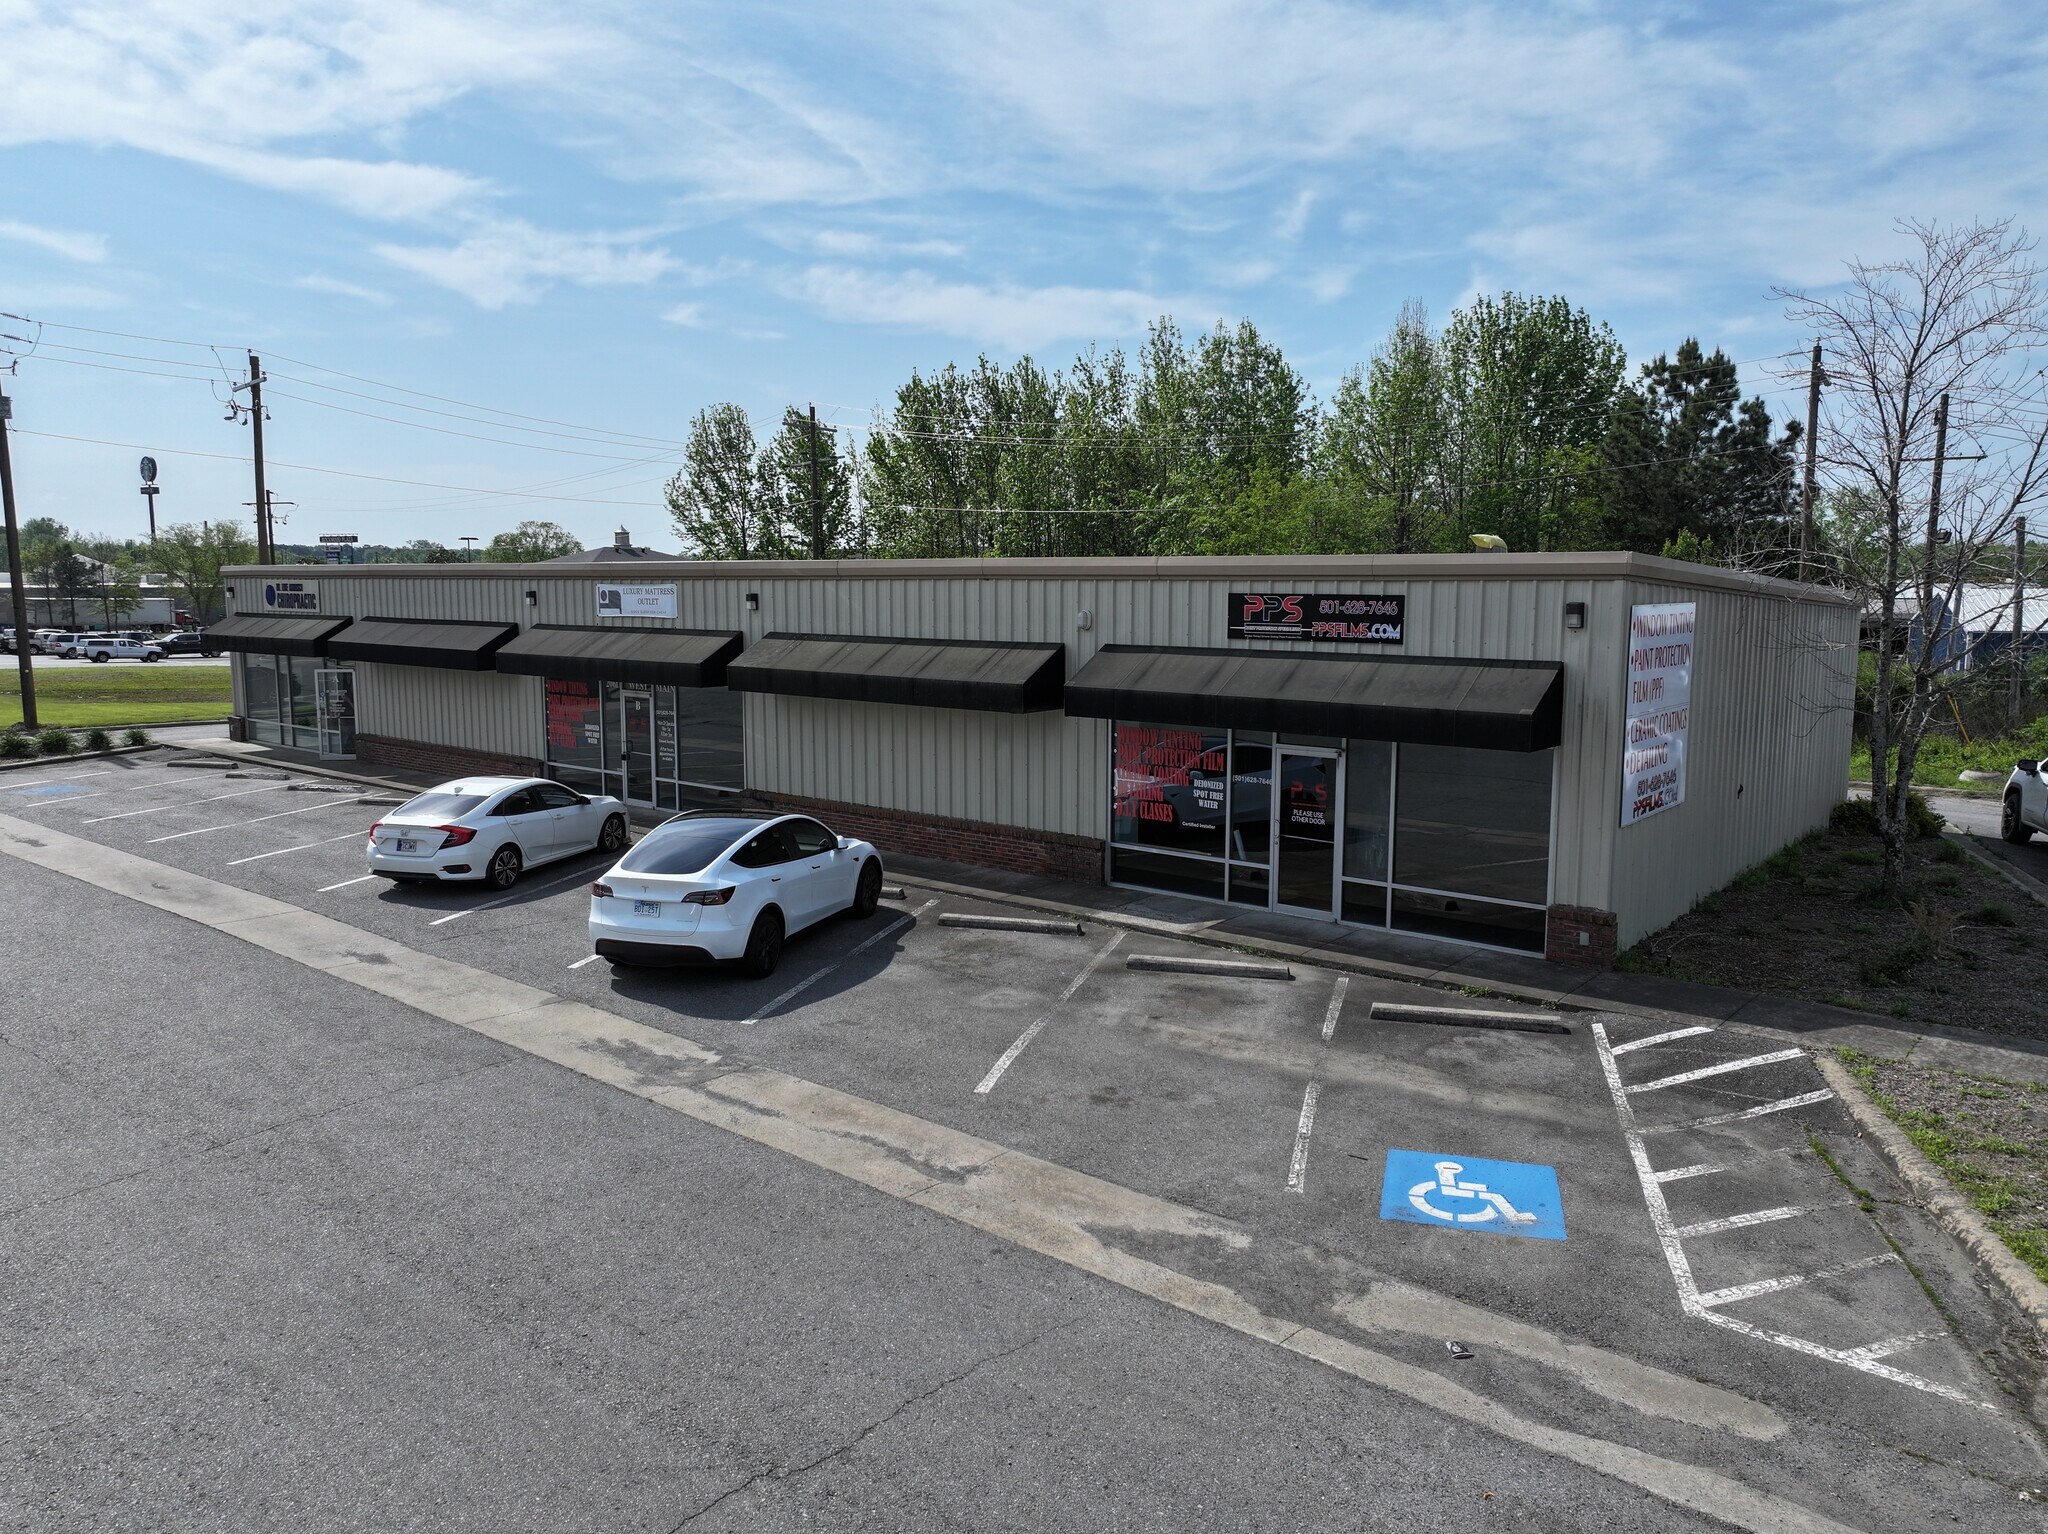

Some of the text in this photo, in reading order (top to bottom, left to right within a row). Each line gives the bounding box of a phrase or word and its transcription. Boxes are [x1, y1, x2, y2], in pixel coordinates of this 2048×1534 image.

[277, 593, 317, 609] CHIROPRACTIC
[1244, 595, 1304, 622] PPS
[1319, 599, 1399, 616] 501-628-7646
[1311, 621, 1401, 639] PPSFILMS.COM
[1634, 643, 1692, 672] PAINT PROTECTION
[1632, 677, 1665, 704] FILM (PPF)
[636, 701, 640, 710] B
[1630, 708, 1688, 744] CERAMIC COATINGS
[1117, 725, 1203, 750] WINDOW TINTING
[1117, 743, 1225, 772] PAINT PROTECTION FILM
[1629, 742, 1668, 775] DETAILING
[1154, 765, 1190, 786] COATING
[1193, 779, 1224, 790] DEIONIZED
[1193, 789, 1224, 801] SPOT FREE
[1198, 799, 1219, 810] WATER
[1139, 801, 1174, 823] CLASSES
[1291, 815, 1326, 826] OTHER DOOR
[1293, 808, 1313, 817] PLEASE
